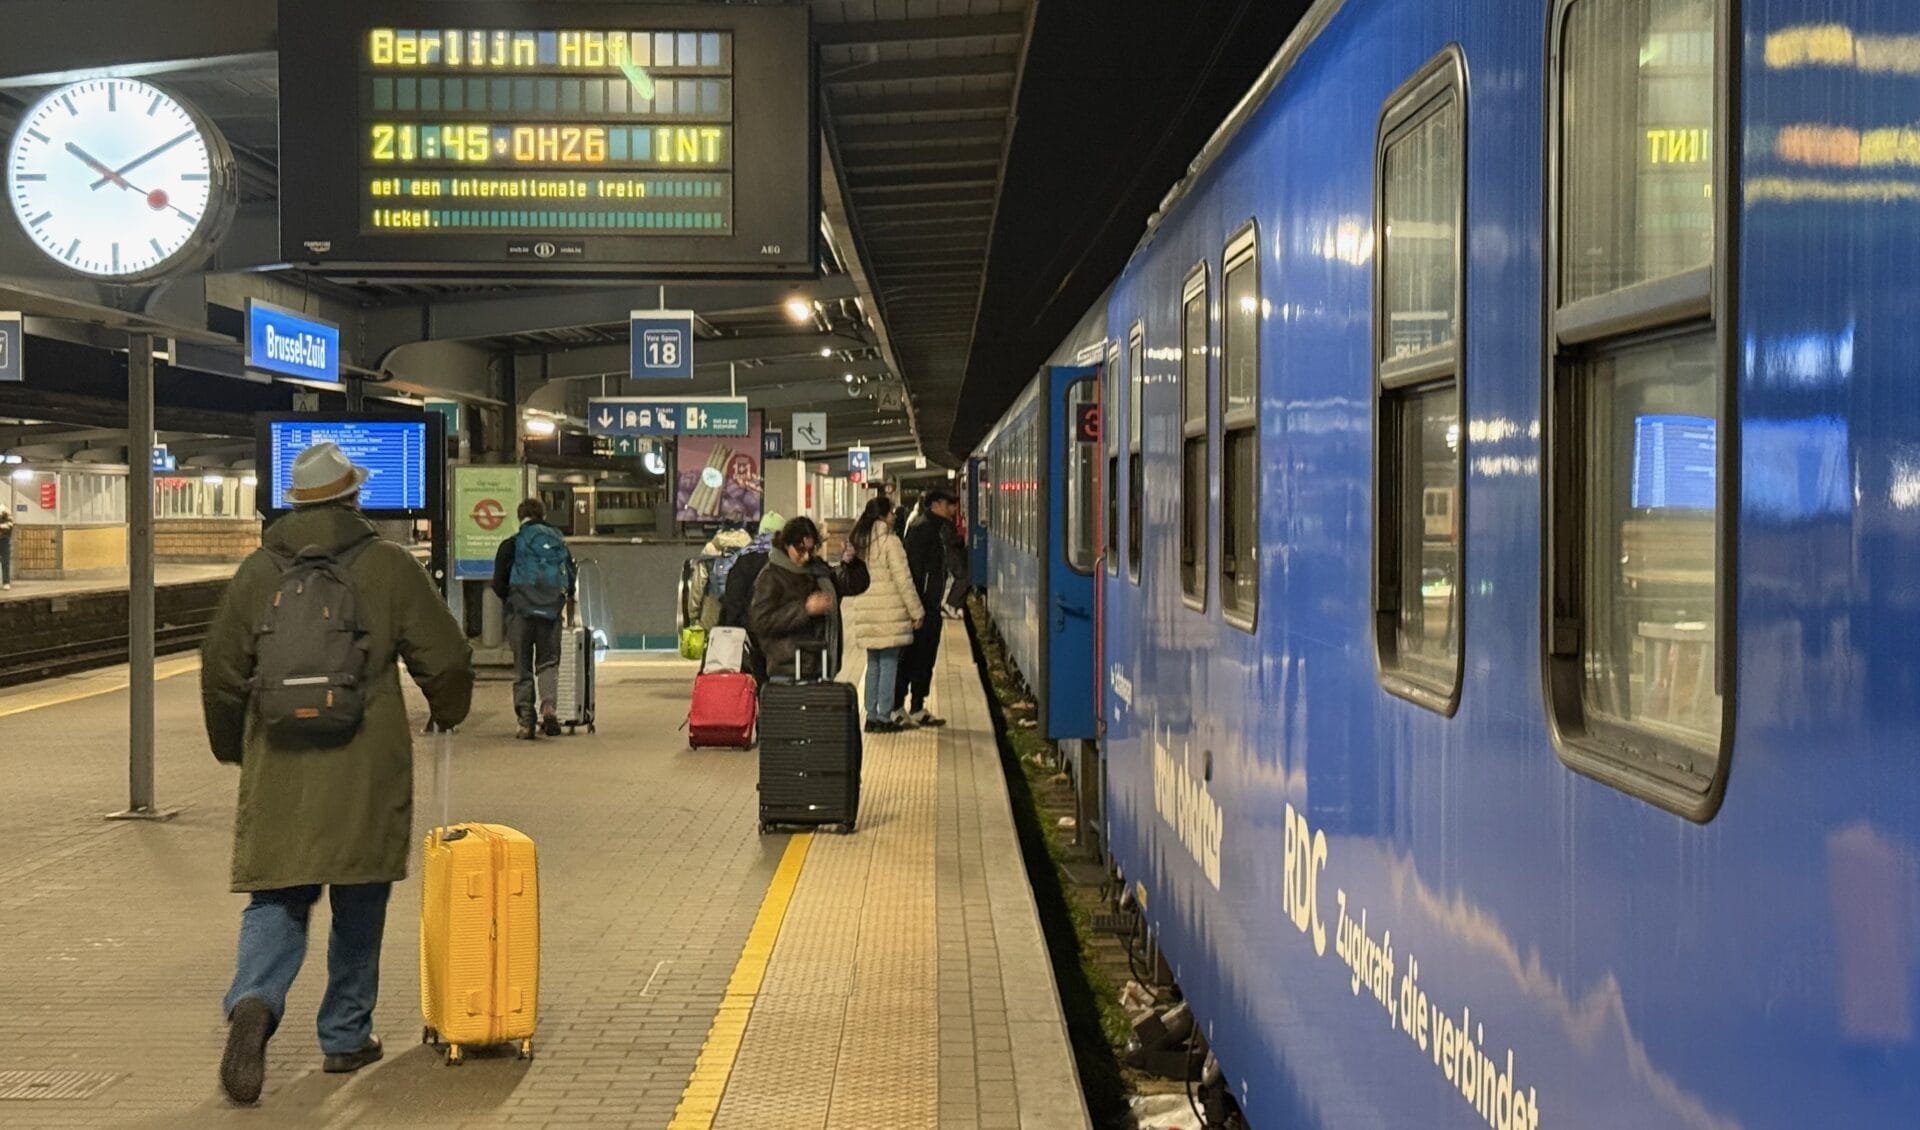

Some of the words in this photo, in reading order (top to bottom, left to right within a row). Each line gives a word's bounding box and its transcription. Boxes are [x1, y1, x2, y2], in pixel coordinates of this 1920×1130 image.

[372, 29, 535, 66] Berlijn
[560, 31, 624, 67] Hbf
[657, 127, 721, 163] INT
[372, 178, 400, 195] met
[411, 180, 441, 196] een
[452, 178, 587, 197] internationale
[598, 180, 645, 197] trein
[373, 209, 439, 227] ticket.
[265, 324, 326, 370] Brussel-Zuid
[649, 342, 676, 365] 18
[1283, 802, 1328, 957] RDC
[1335, 887, 1398, 1030] Zugkraft,
[1401, 953, 1428, 1051] die
[1432, 1004, 1539, 1130] verbindet
